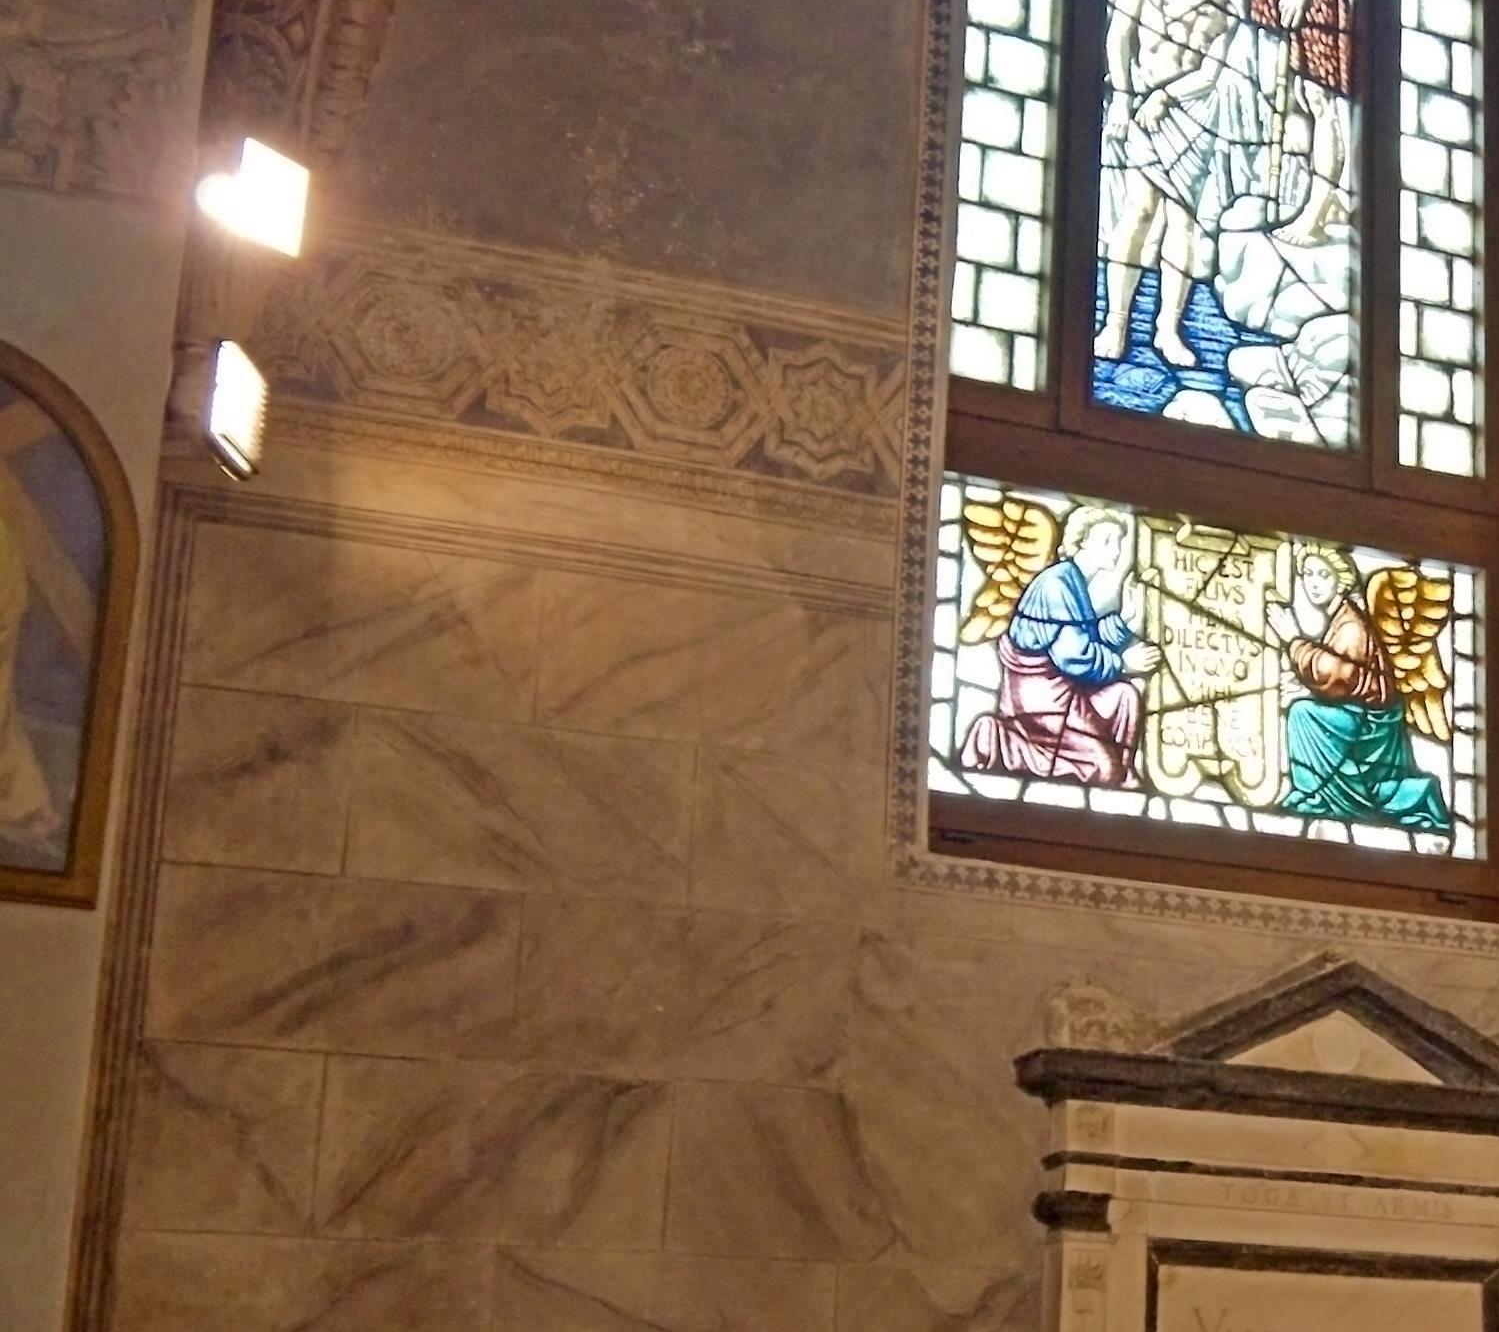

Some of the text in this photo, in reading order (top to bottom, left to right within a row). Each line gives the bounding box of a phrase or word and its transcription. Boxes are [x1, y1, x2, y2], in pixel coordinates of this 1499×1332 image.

[1175, 549, 1208, 575] HIC
[1163, 624, 1262, 657] DILECTVS
[1219, 1181, 1300, 1209] TOGA
